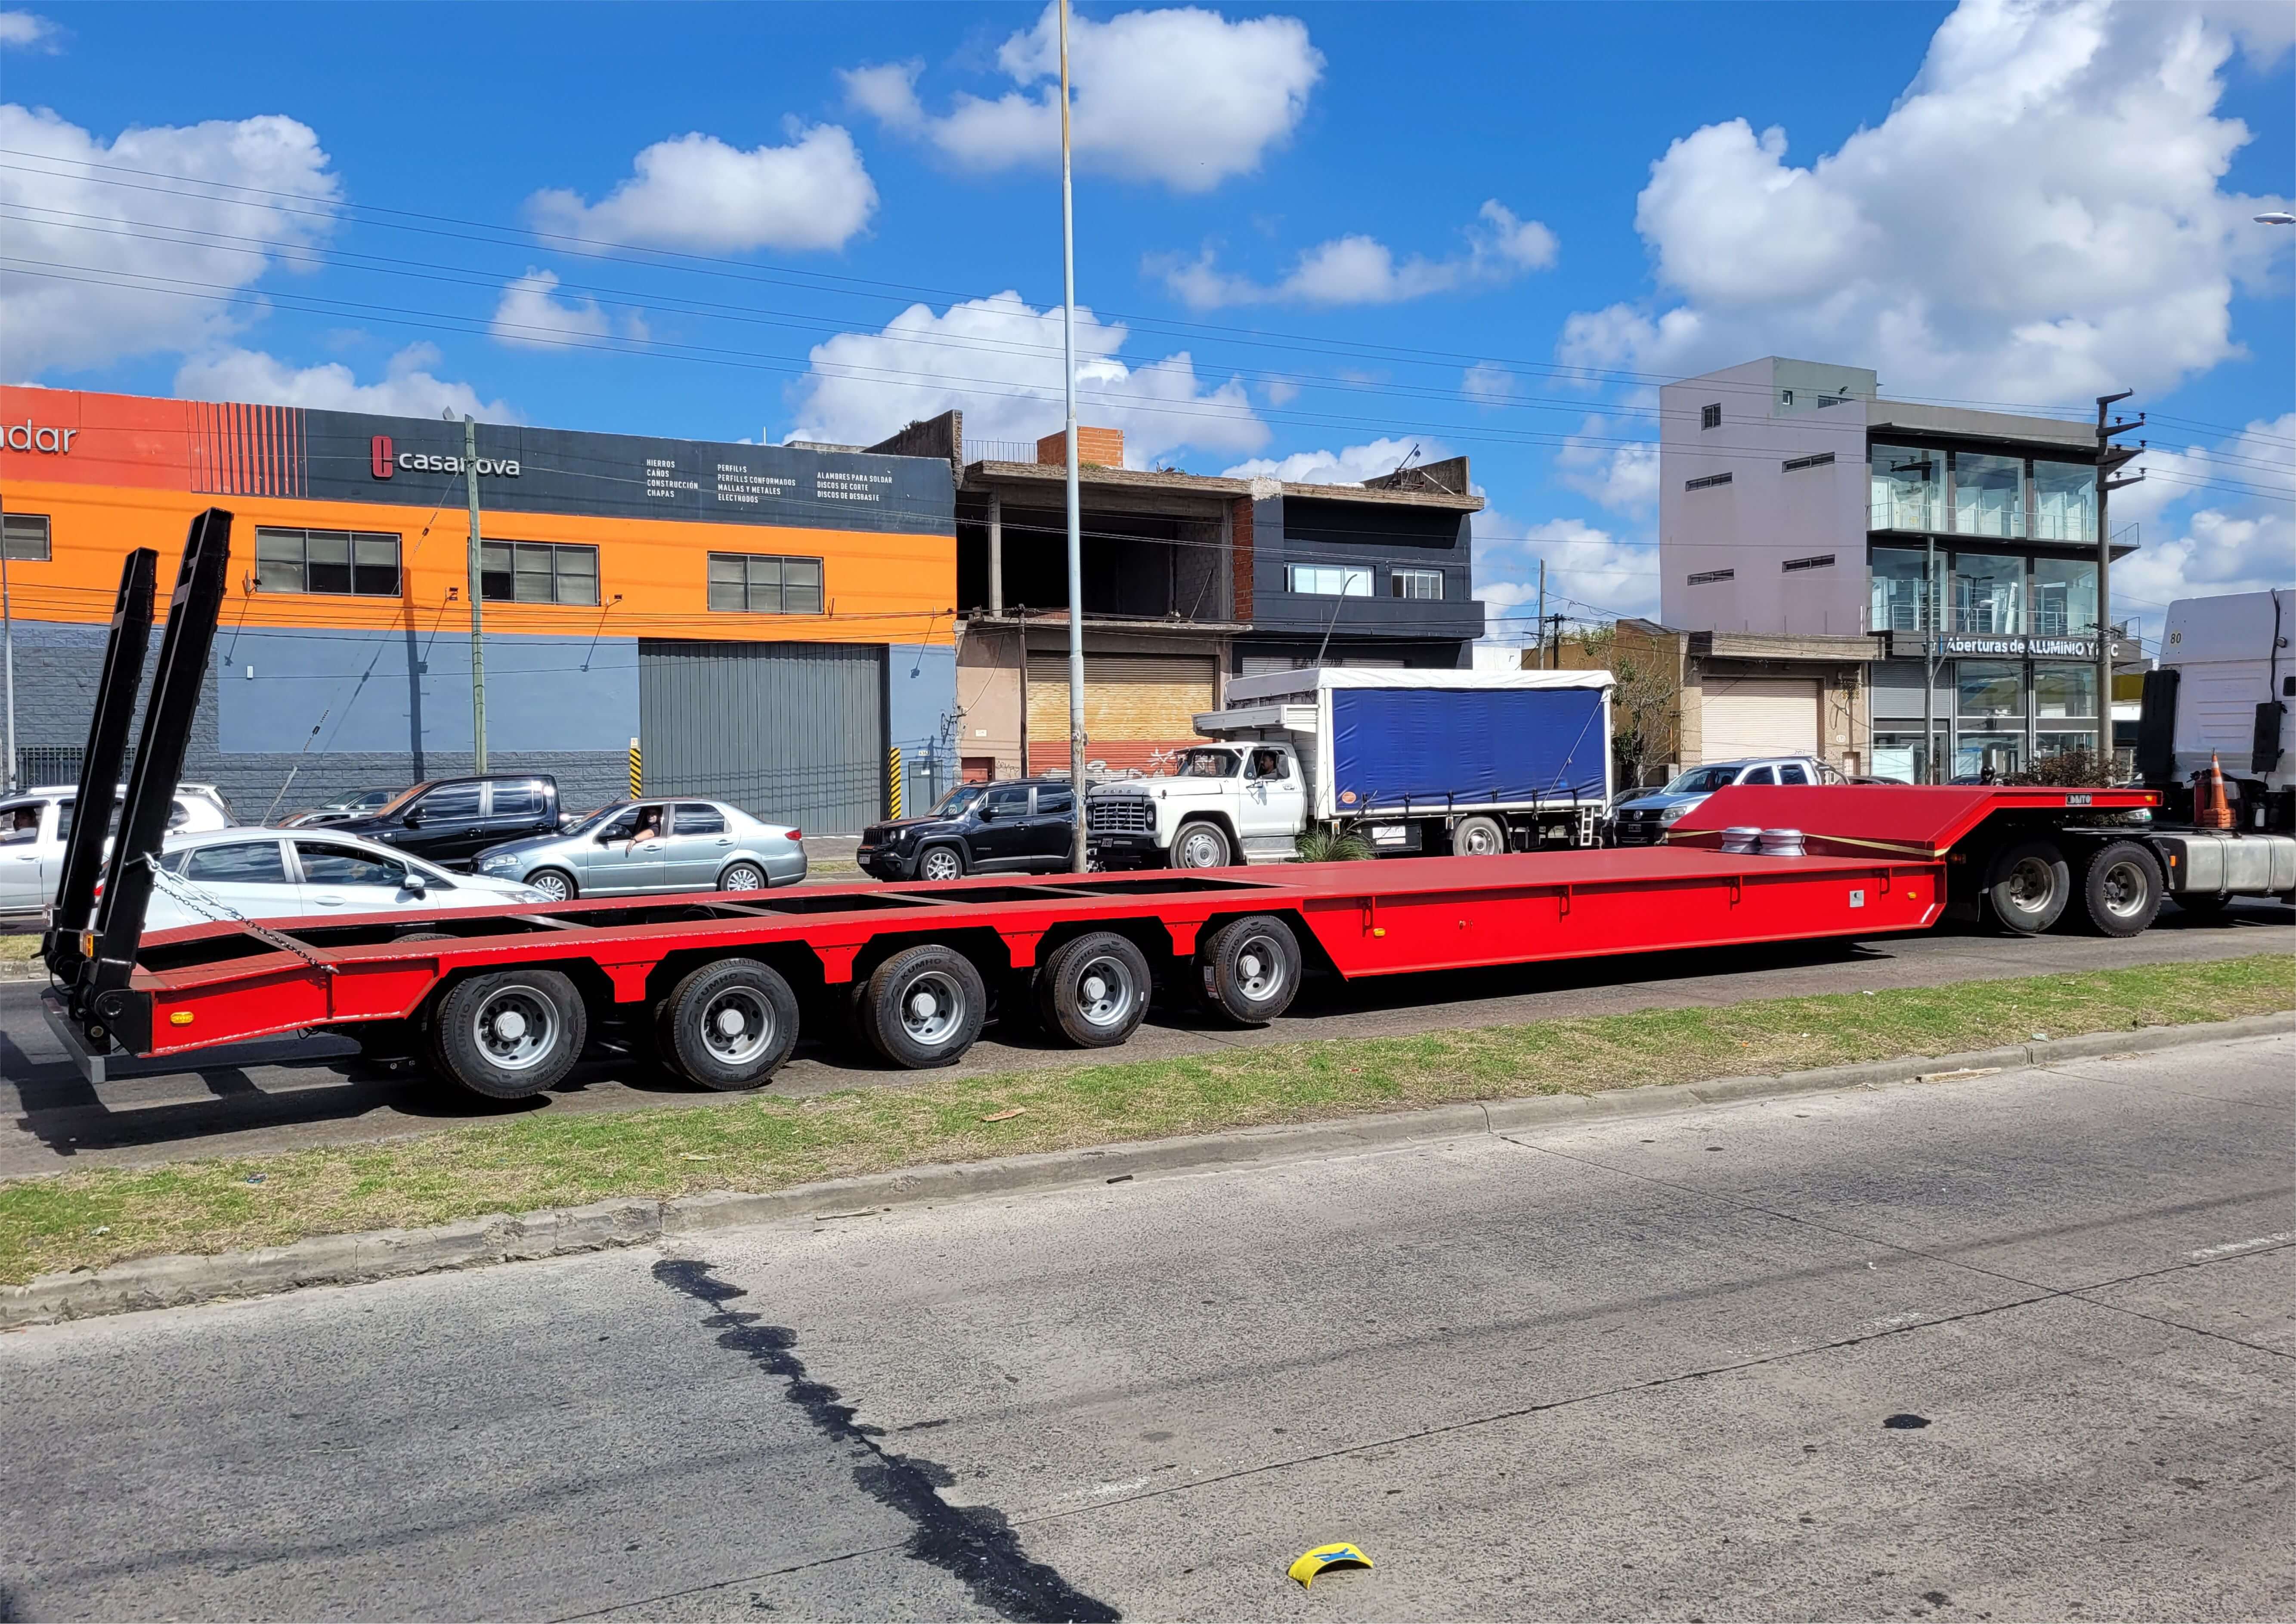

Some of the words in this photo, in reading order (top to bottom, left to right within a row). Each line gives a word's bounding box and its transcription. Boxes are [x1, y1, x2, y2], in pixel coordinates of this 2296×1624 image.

[647, 459, 675, 468] HIERROS
[647, 468, 669, 477] CAÑOS
[817, 472, 850, 480] ALAMBRES
[647, 479, 698, 489] CONSTRUCCIÓN
[749, 476, 796, 486] CONFORMADOS
[718, 484, 744, 492] MALLAS
[752, 486, 780, 495] METALES
[718, 494, 758, 503] ELECTRODOS
[849, 493, 879, 501] DESBASTE
[2170, 633, 2181, 644] 80
[1947, 637, 2008, 653] Aberturas
[2010, 639, 2025, 653] de
[2028, 640, 2084, 656] ALUMINIO
[2086, 643, 2094, 656] Y
[1226, 939, 1239, 971] UMHO
[901, 958, 941, 980] KUMHO
[1067, 949, 1094, 984] KUMHO
[695, 973, 737, 1005] KUMHO
